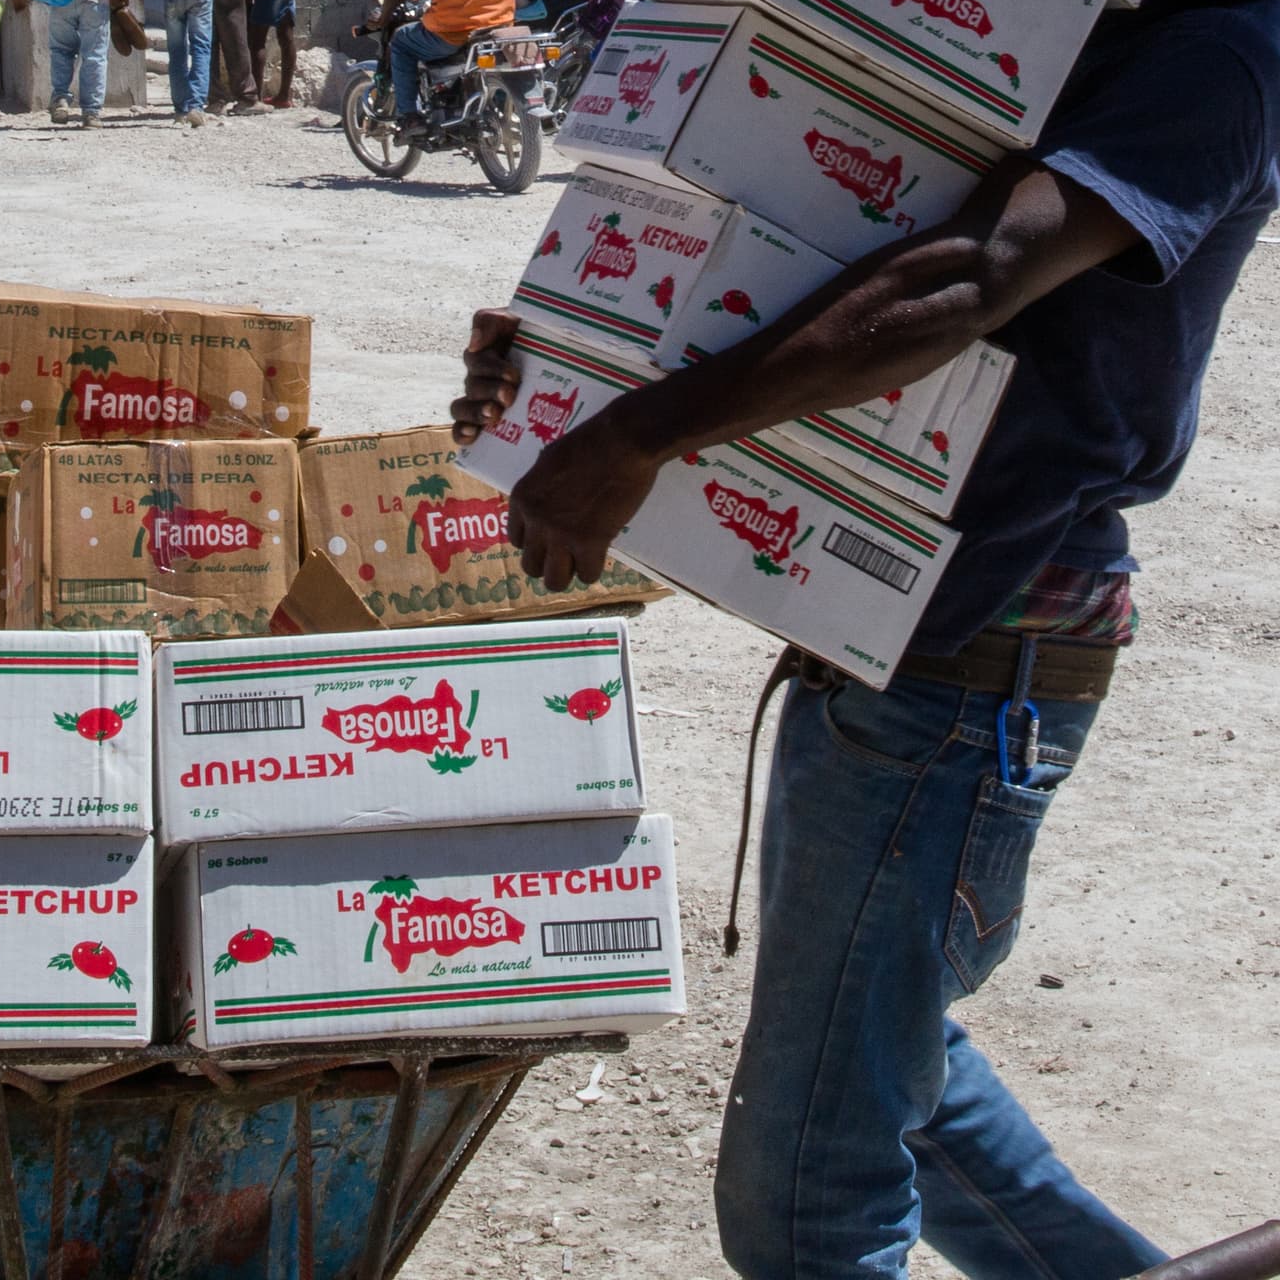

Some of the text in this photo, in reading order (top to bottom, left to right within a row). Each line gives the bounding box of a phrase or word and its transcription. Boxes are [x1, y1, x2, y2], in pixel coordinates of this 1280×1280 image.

[946, 39, 984, 60] natural
[813, 139, 917, 235] La Famosa
[639, 224, 709, 259] KETCHUP
[763, 233, 796, 256] Sobres
[48, 326, 252, 351] NECTAR DE PERA
[37, 356, 195, 423] La Famosa
[316, 439, 379, 456] 48 LATAS
[59, 455, 123, 466] 48 LATAS
[216, 455, 277, 466] 10.5 ONZ.
[379, 451, 458, 471] NECTA
[712, 459, 747, 479] natural
[78, 472, 256, 484] NECTAR DE PERA
[112, 496, 249, 549] La Famosa
[377, 495, 510, 547] La Famos
[711, 491, 810, 586] La Famosa
[229, 561, 271, 574] natural
[844, 644, 875, 665] Sobres
[314, 676, 418, 696] Lo más natural
[339, 707, 509, 760] La Famosa
[180, 752, 354, 787] KETCHUP
[576, 779, 634, 791] 96 Sobres
[50, 797, 103, 817] LOTE
[123, 803, 138, 812] 96
[204, 808, 219, 818] 57
[623, 835, 637, 845] 57
[107, 853, 122, 862] 57
[207, 856, 268, 869] 96 Sobres
[493, 866, 661, 899] KETCHUP
[336, 890, 508, 944] La Famosa
[428, 956, 532, 977] Lo más natural
